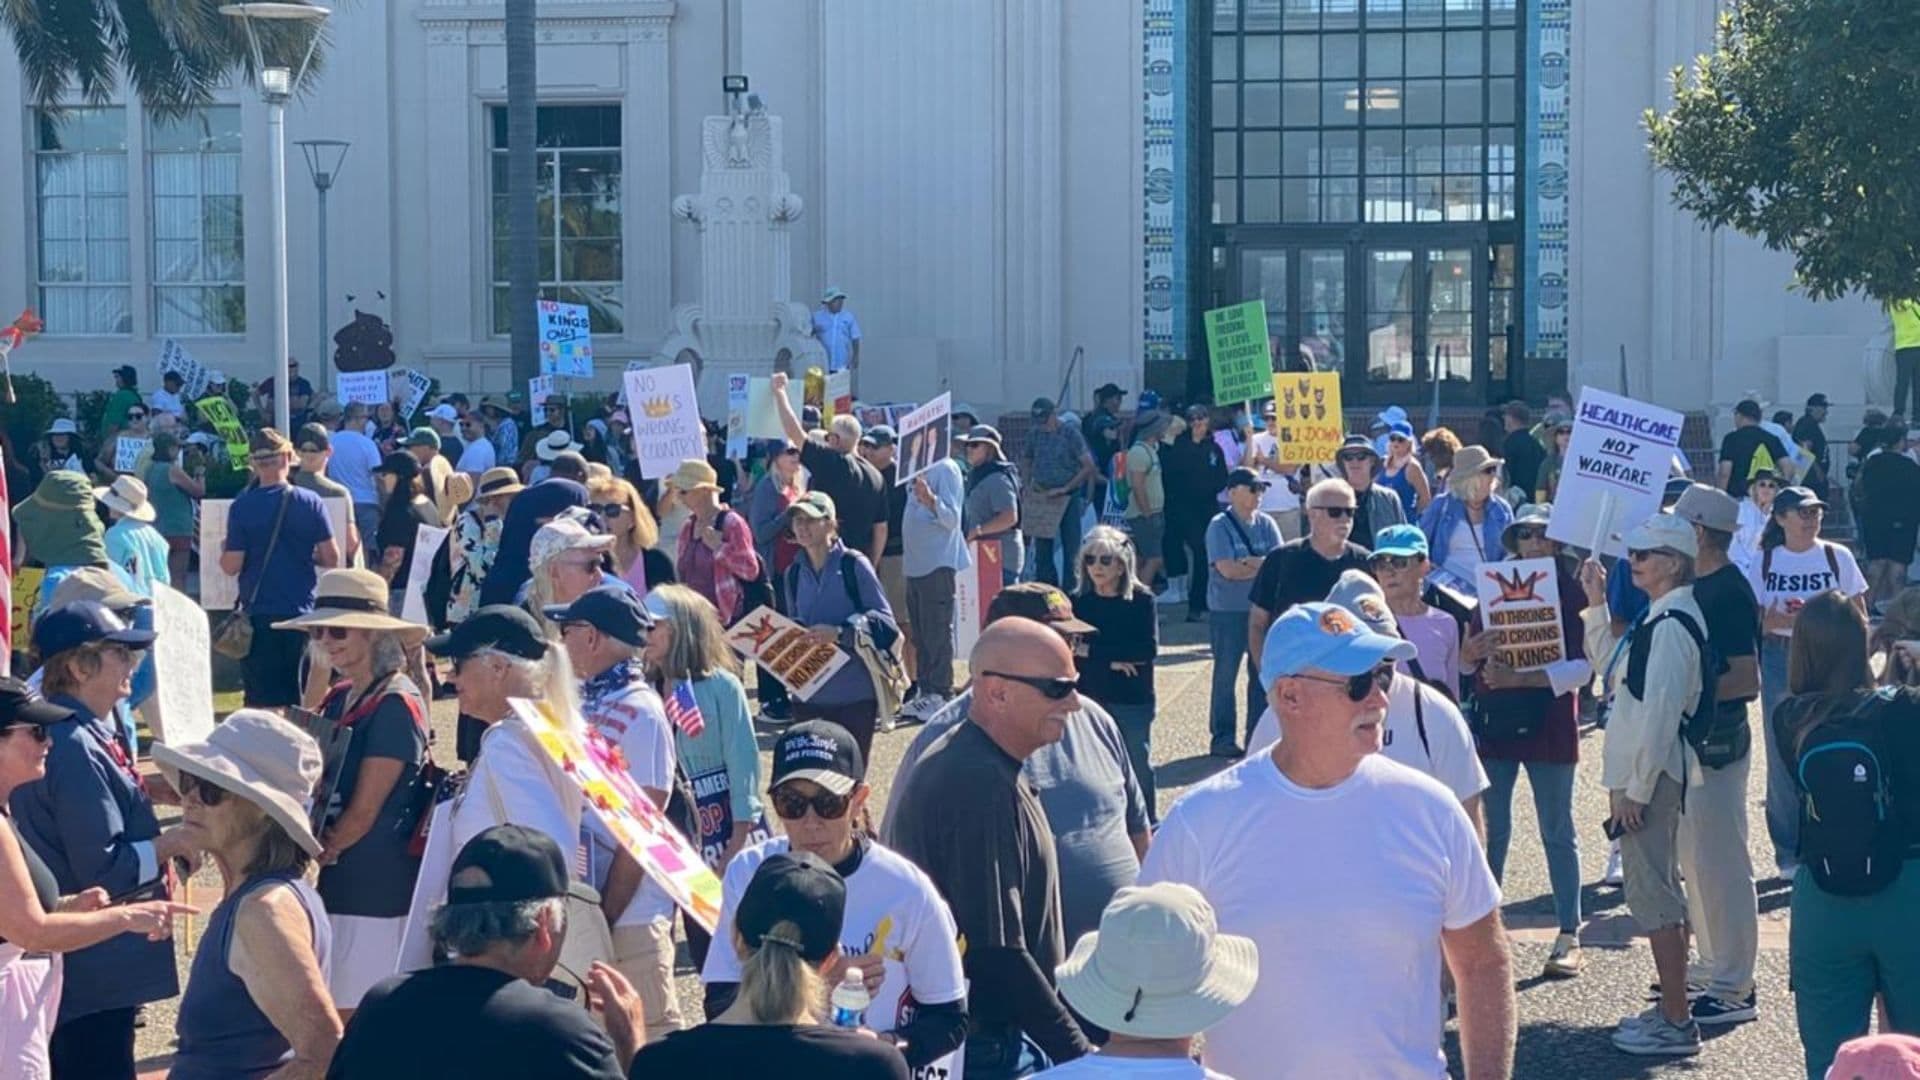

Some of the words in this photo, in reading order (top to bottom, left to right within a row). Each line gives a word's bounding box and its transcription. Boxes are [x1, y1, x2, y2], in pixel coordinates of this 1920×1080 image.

[541, 301, 559, 312] NO
[548, 314, 588, 328] KINGS
[1231, 333, 1250, 346] LOVE
[1216, 344, 1262, 361] DEMOCRACY
[1234, 359, 1254, 372] LOVE
[635, 374, 656, 392] NO
[1223, 371, 1257, 387] AMERICA
[637, 418, 685, 436] WRONG
[1581, 402, 1679, 441] HEALTHCARE
[641, 434, 698, 457] COUNTRY
[1602, 438, 1641, 455] NOT
[1579, 455, 1652, 486] WARFARE
[1766, 572, 1832, 592] RESIST
[1489, 610, 1505, 625] NO
[1506, 607, 1556, 624] THRONES
[1510, 625, 1559, 643] CROWNS
[1517, 644, 1561, 666] KINGS
[785, 667, 811, 690] NO
[801, 643, 836, 675] KINGS
